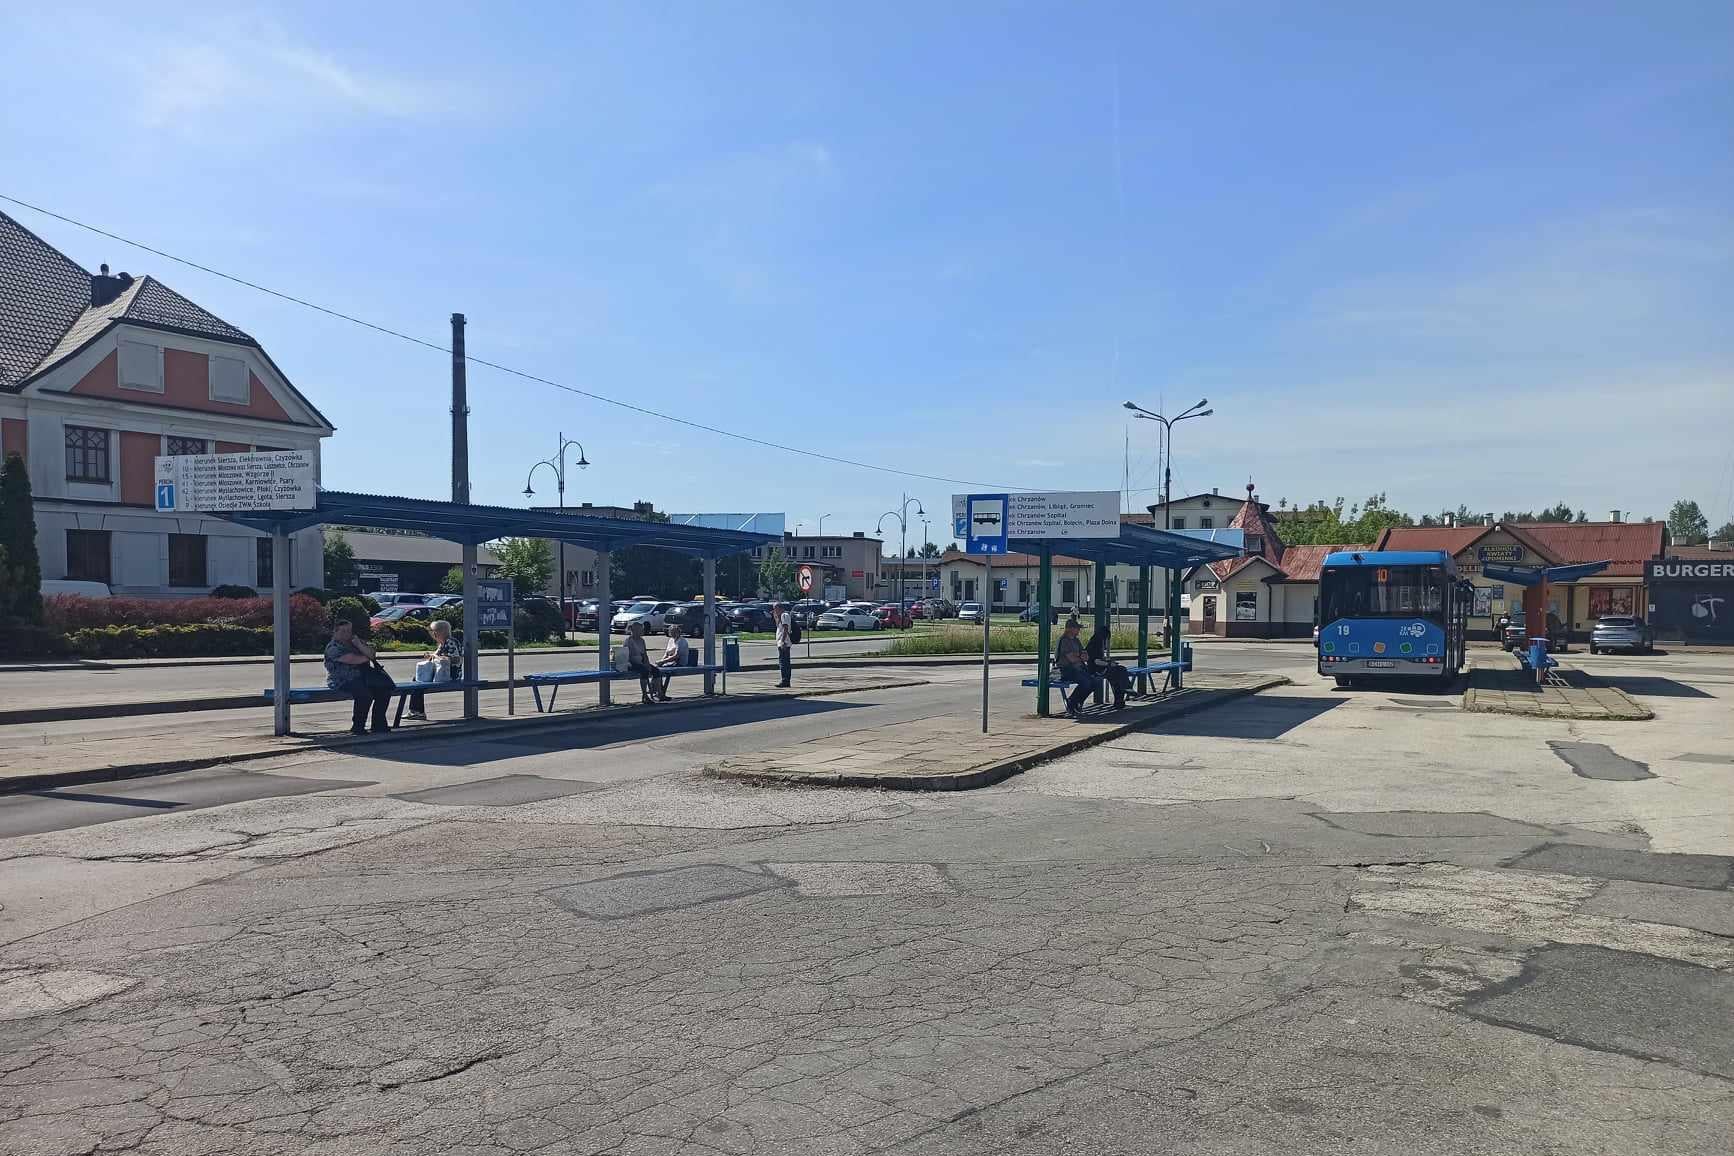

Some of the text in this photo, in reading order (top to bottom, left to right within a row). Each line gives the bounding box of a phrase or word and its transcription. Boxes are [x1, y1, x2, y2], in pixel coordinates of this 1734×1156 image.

[160, 487, 170, 506] 1
[1376, 569, 1388, 583] 10
[1653, 564, 1734, 577] BURGER
[1337, 625, 1350, 636] 19
